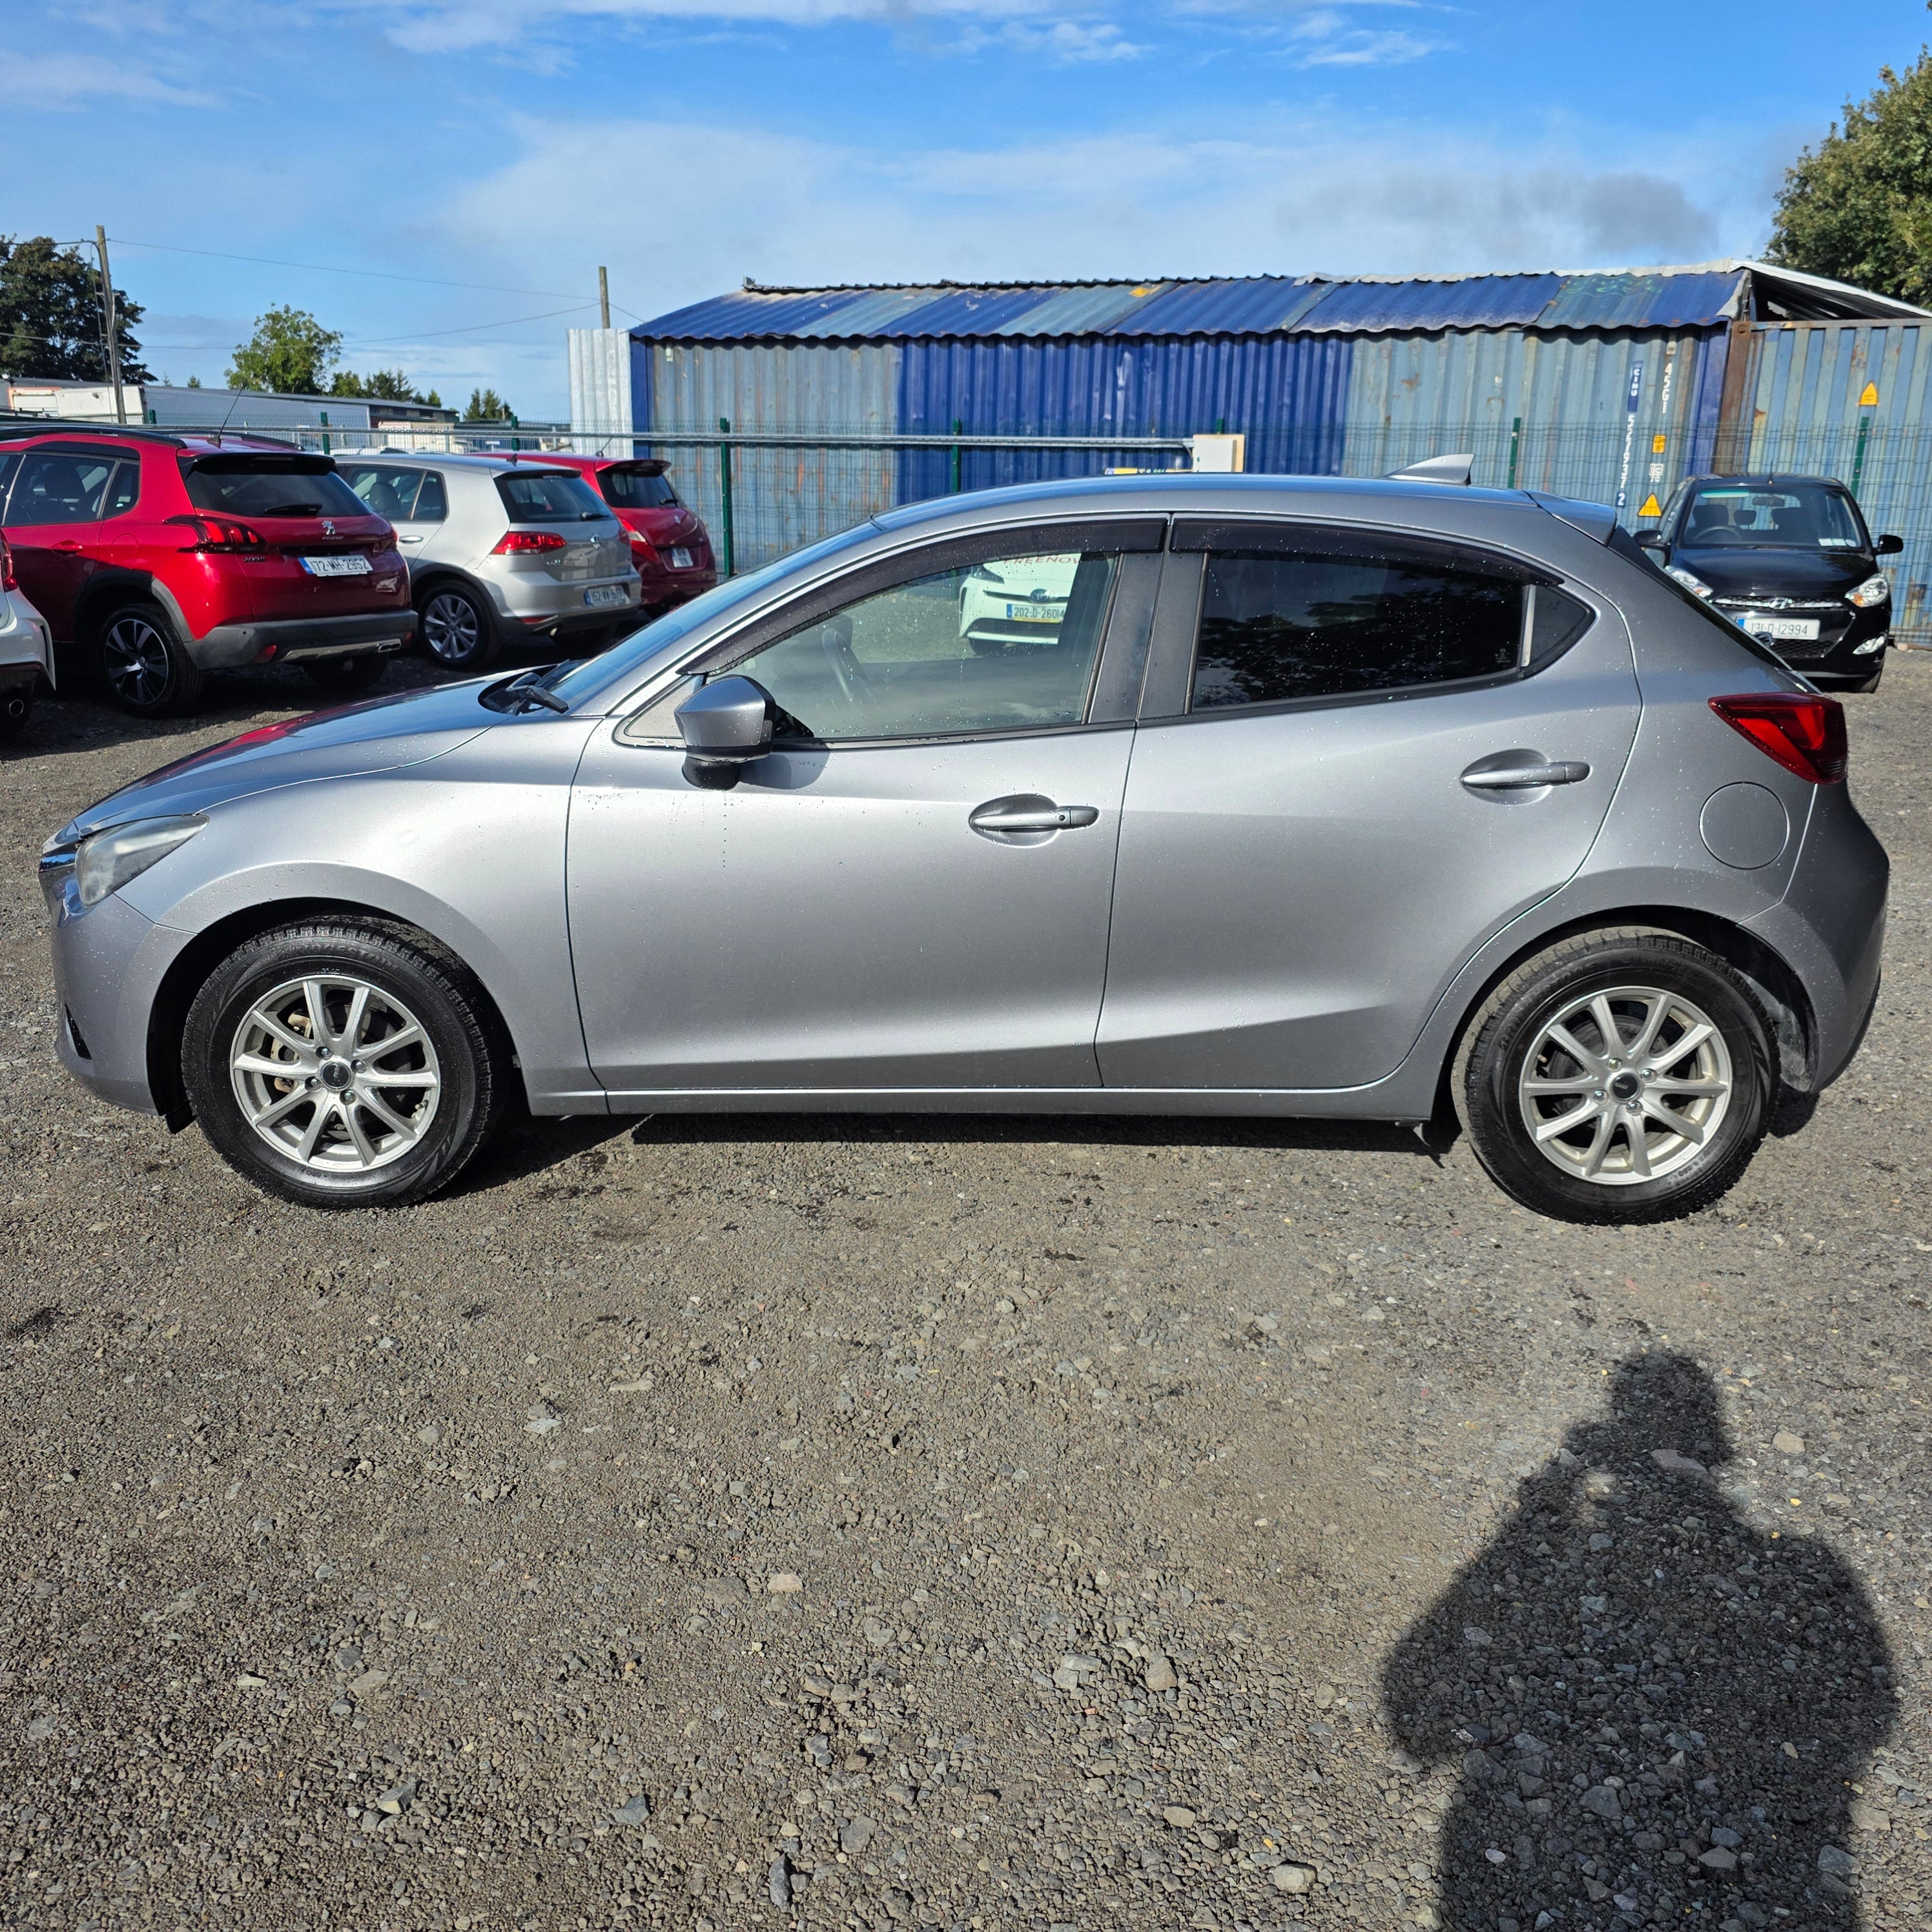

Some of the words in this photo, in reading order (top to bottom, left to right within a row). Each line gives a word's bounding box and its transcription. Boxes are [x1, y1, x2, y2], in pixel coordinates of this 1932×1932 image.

[1661, 362, 1672, 414] 45G1
[1618, 493, 1626, 506] 2
[309, 558, 369, 572] 172-MH-2952
[1751, 622, 1808, 635] 131-D-12994
